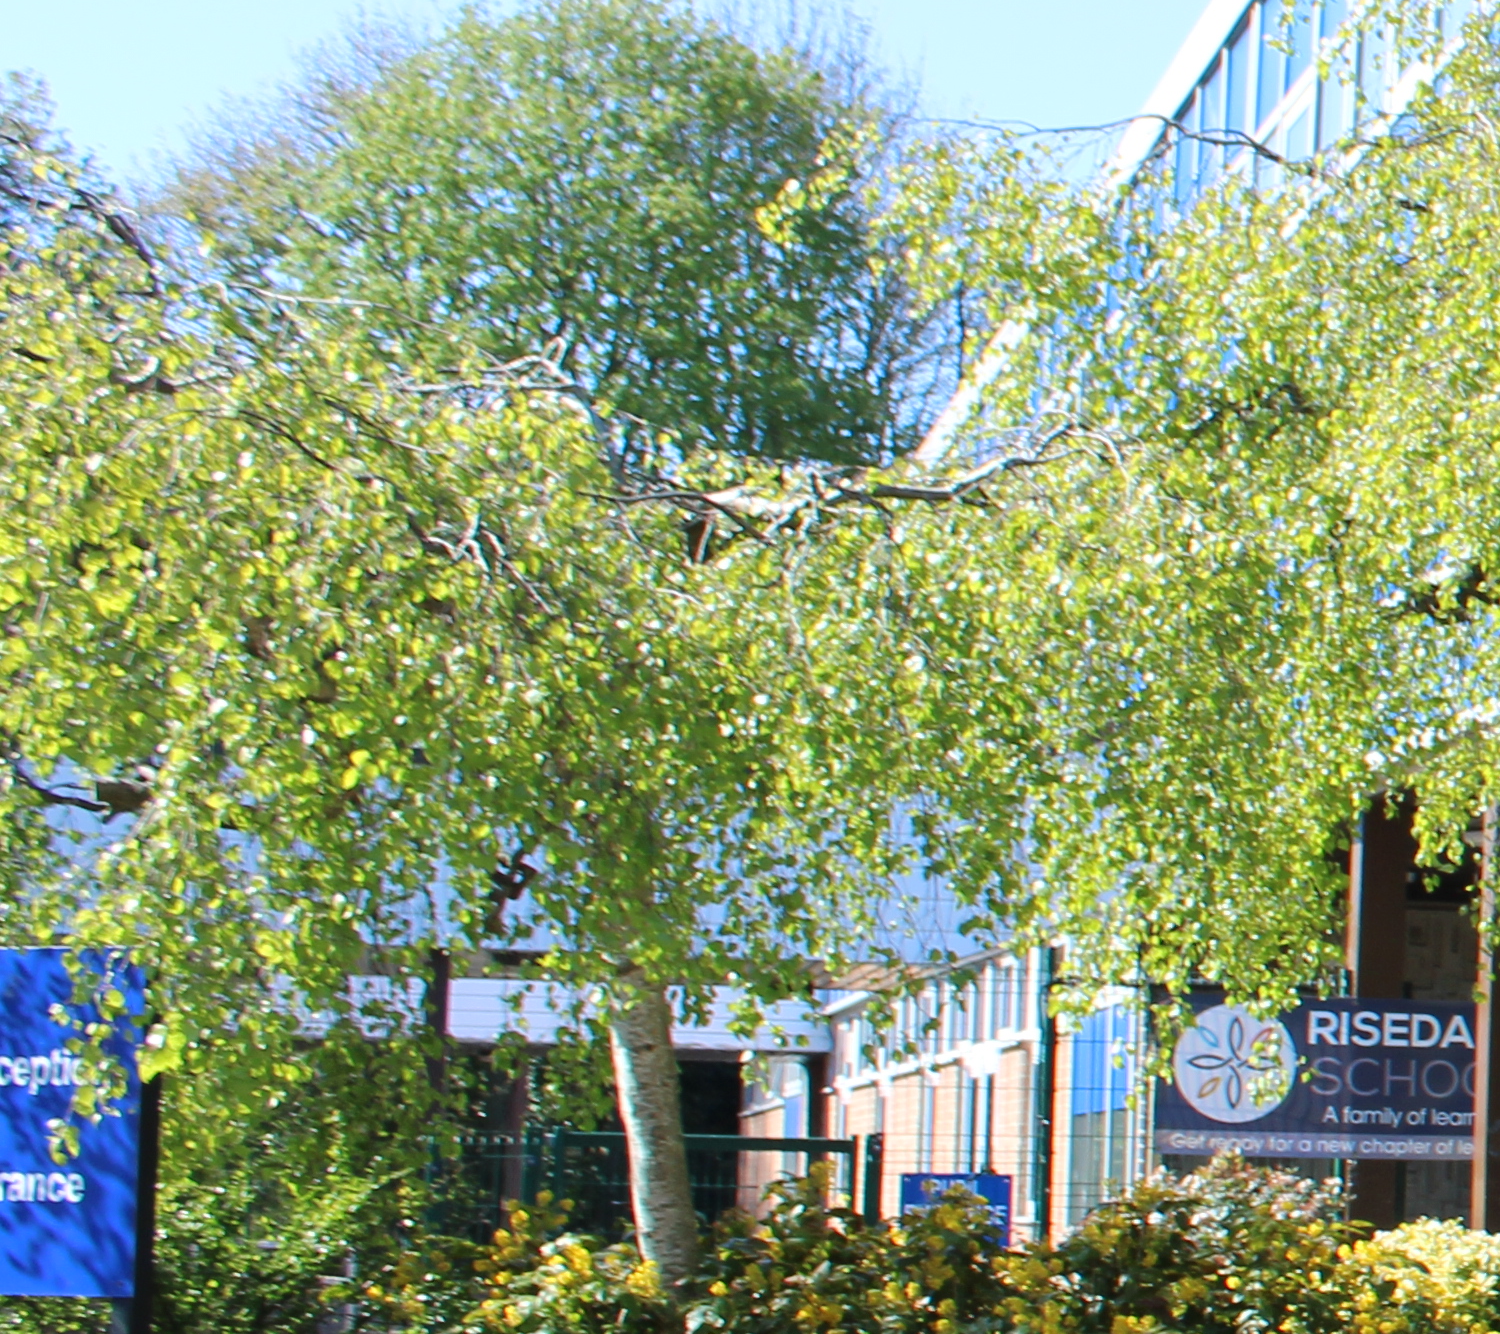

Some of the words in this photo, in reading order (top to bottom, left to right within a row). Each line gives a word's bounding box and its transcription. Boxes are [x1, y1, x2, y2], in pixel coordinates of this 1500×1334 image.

[1307, 1010, 1476, 1049] RISEDA
[1321, 1106, 1339, 1124] A
[1342, 1105, 1403, 1128] family
[1406, 1107, 1427, 1126] of
[1170, 1133, 1206, 1149] Get
[1268, 1136, 1294, 1152] for
[1299, 1140, 1312, 1152] a
[1316, 1139, 1356, 1153] new
[1359, 1138, 1432, 1157] chapter
[1434, 1139, 1455, 1155] of
